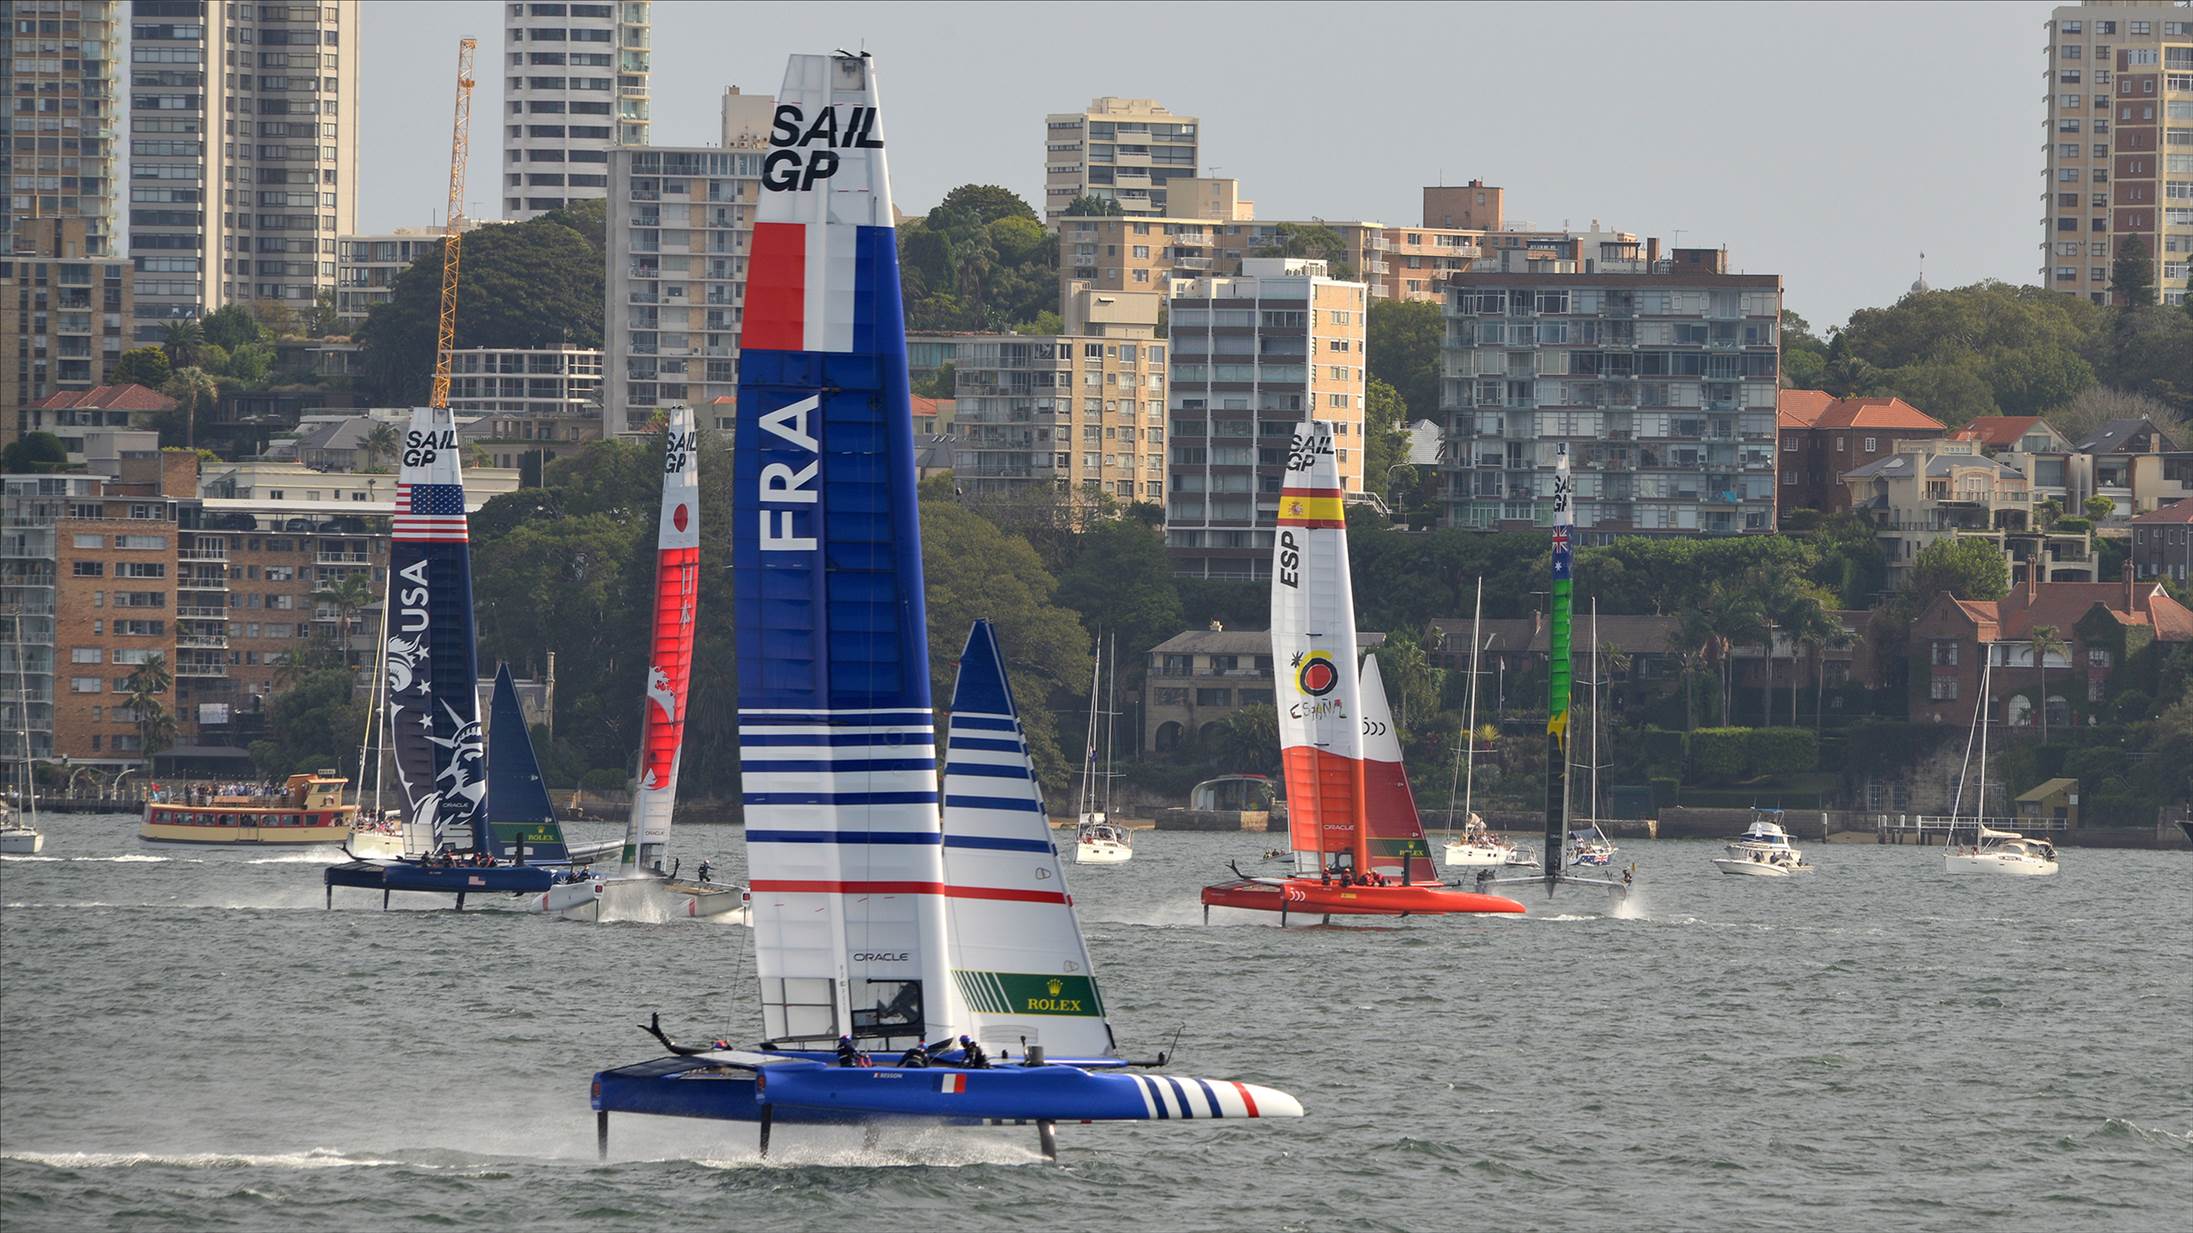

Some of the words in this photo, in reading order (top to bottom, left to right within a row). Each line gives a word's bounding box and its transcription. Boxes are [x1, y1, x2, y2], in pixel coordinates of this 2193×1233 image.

[769, 105, 884, 148] SAIL
[761, 149, 840, 192] GP
[406, 430, 458, 450] SAIL
[667, 431, 697, 452] SAIL
[1290, 434, 1335, 455] SAIL
[403, 449, 437, 467] GP
[664, 453, 687, 473] GP
[1286, 453, 1316, 472] GP
[759, 394, 819, 551] FRA
[1554, 475, 1571, 493] SAL
[1280, 530, 1299, 589] ESP
[400, 559, 430, 632] USA
[853, 952, 909, 962] ORACLE
[1027, 998, 1082, 1012] ROLEX
